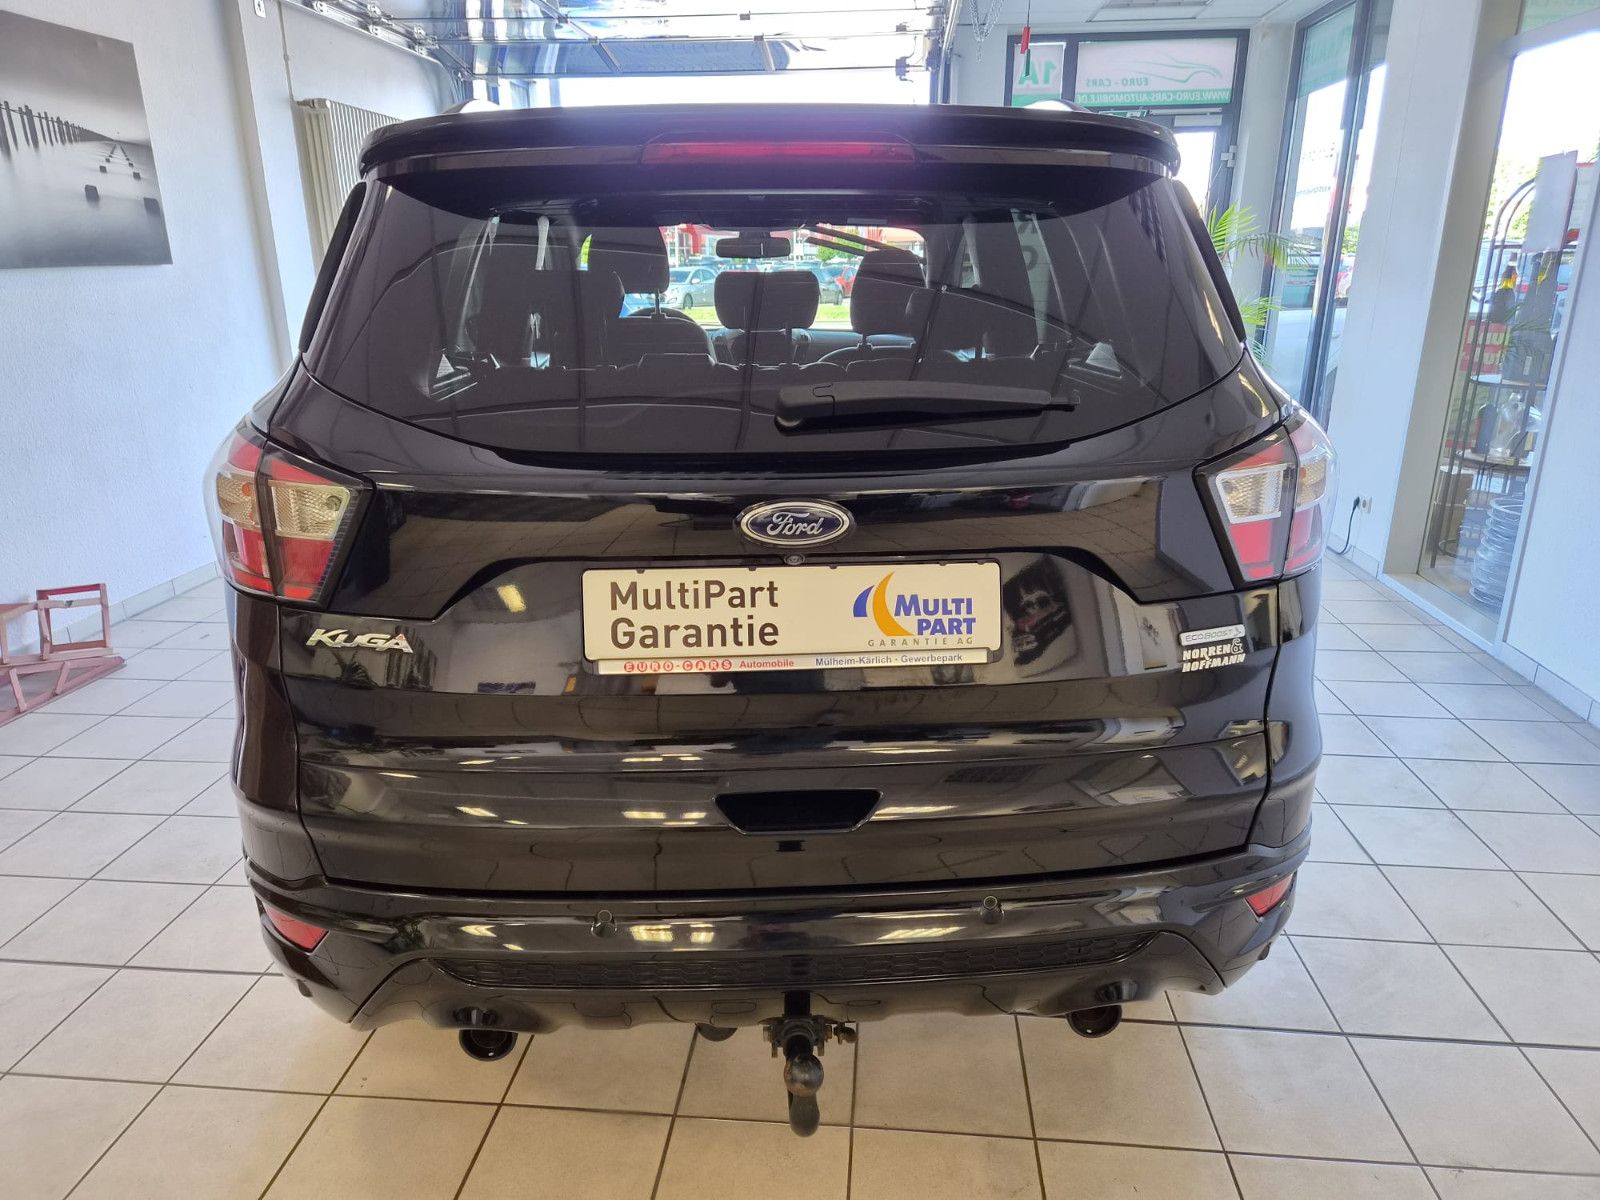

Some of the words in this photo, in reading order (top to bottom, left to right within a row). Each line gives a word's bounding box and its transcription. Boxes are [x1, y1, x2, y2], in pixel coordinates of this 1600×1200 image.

[766, 511, 824, 536] Ford
[610, 579, 779, 611] MultiPart
[894, 593, 973, 617] MULTI
[610, 614, 779, 650] Garantie
[917, 617, 977, 636] PART
[306, 628, 414, 654] KUGA
[867, 637, 948, 648] GARANTIE
[957, 636, 974, 645] AG
[623, 658, 733, 673] EURO-CARS
[739, 658, 795, 670] Automobile
[815, 656, 893, 667] Mülheim-Kärlich
[900, 654, 964, 665] Gewerbepark
[1181, 653, 1247, 673] HOFFMANN
